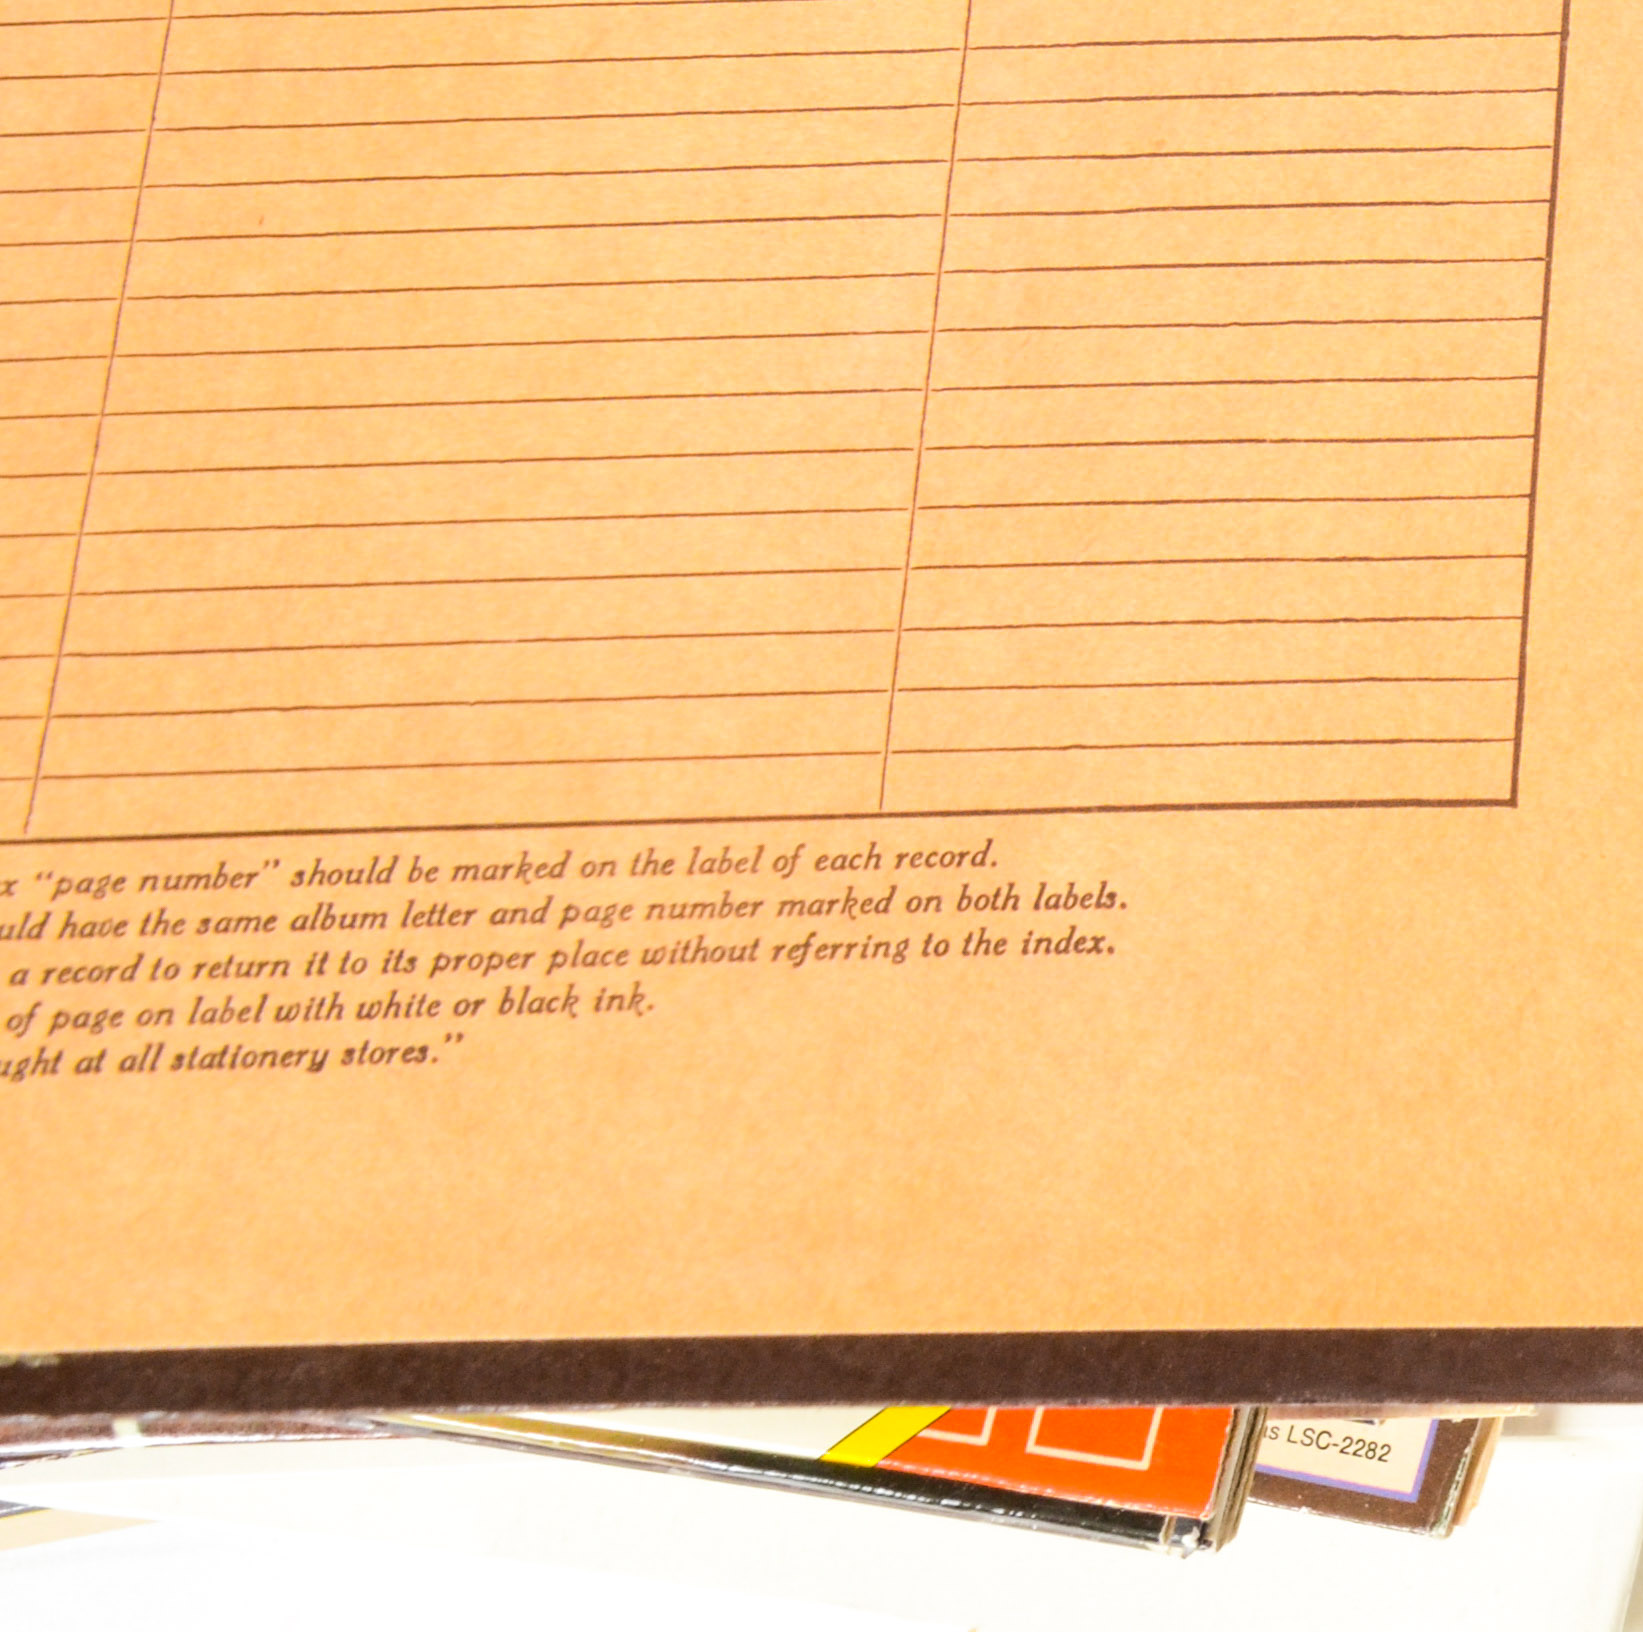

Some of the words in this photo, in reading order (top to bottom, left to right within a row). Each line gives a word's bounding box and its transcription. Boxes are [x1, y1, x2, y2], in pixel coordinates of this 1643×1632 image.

[290, 855, 393, 888] should
[407, 854, 439, 883] be
[451, 850, 567, 884] marked
[580, 859, 617, 879] on
[630, 844, 675, 878] the
[687, 844, 763, 876] label
[772, 842, 806, 879] of
[814, 841, 884, 873] each
[894, 838, 998, 871] record.
[139, 907, 187, 939] the
[199, 913, 277, 936] same
[290, 902, 388, 933] album
[401, 899, 479, 930] letter
[489, 895, 555, 927] and
[558, 898, 634, 930] page
[645, 891, 764, 922] number
[777, 885, 897, 921] marked
[905, 892, 944, 916] on
[956, 883, 1020, 913] both
[1033, 880, 1128, 912] labels.
[9, 968, 29, 986] a
[41, 953, 141, 986] record
[149, 955, 181, 982] to
[192, 953, 291, 982] return
[304, 949, 332, 979] it
[337, 949, 369, 977] to
[380, 947, 418, 974] its
[430, 948, 537, 980] proper
[546, 938, 629, 971] place
[640, 933, 760, 967] without
[771, 931, 910, 968] referring
[922, 931, 952, 958] to
[961, 926, 1008, 958] the
[1020, 925, 1115, 958] index.
[6, 1000, 42, 1039] of
[48, 1008, 124, 1037] page
[136, 1003, 175, 1028] on
[188, 994, 268, 1026] label
[275, 991, 345, 1023] with
[356, 987, 442, 1021] white
[452, 994, 486, 1019] or
[498, 984, 580, 1019] black
[594, 981, 655, 1018] ink.
[74, 1048, 107, 1074] at
[120, 1044, 160, 1072] all
[170, 1038, 329, 1076] stationery
[1286, 1424, 1392, 1463] LSC-2282
